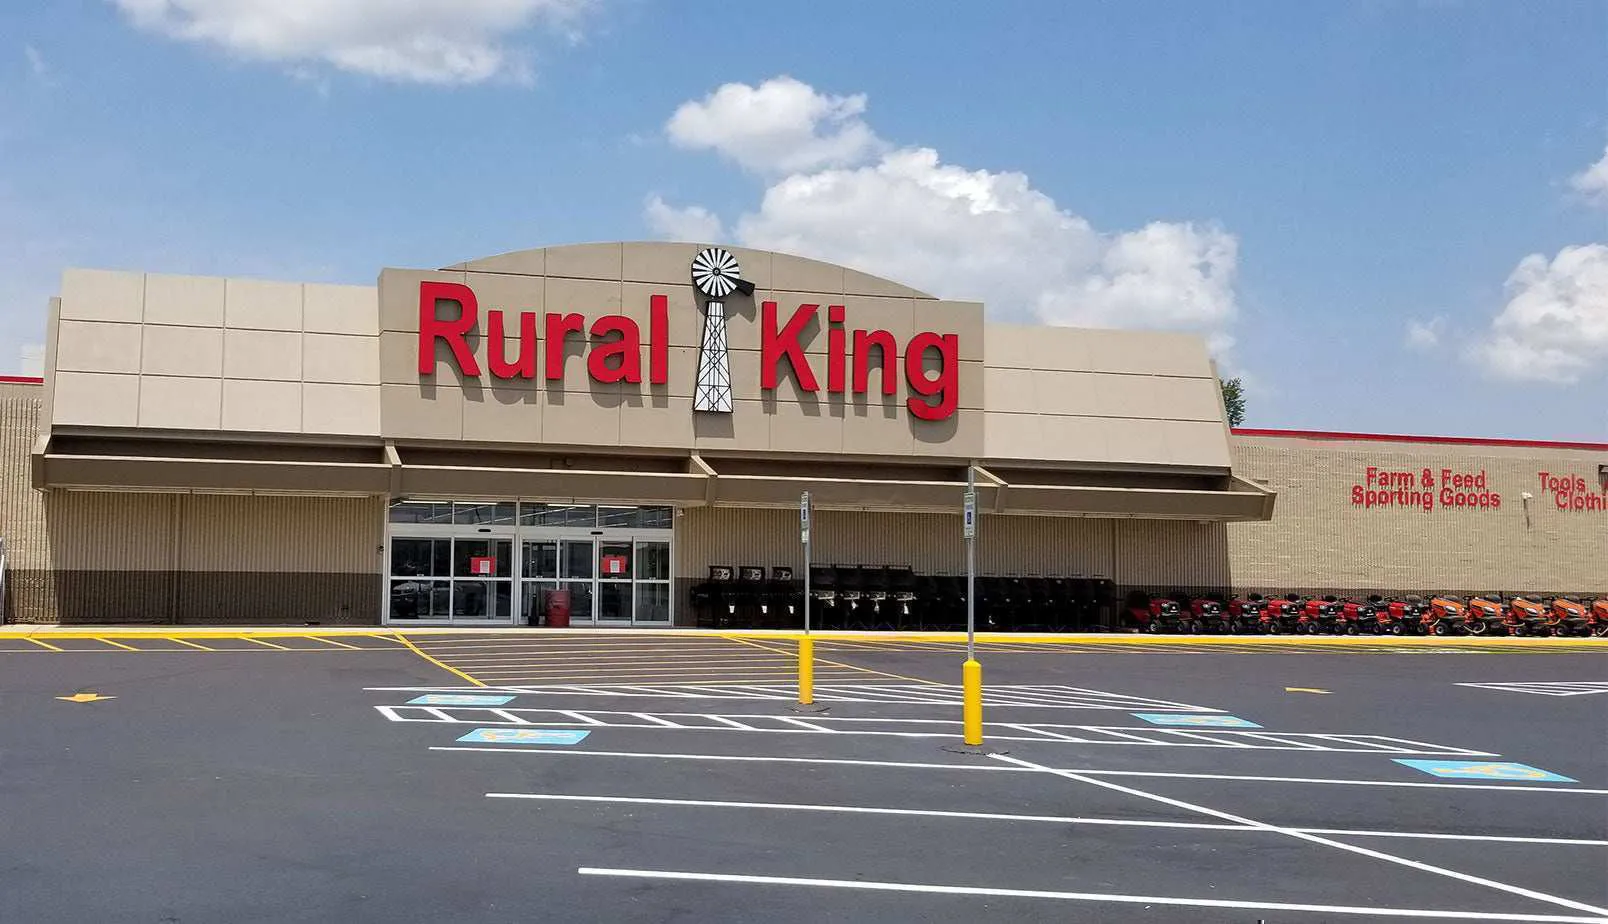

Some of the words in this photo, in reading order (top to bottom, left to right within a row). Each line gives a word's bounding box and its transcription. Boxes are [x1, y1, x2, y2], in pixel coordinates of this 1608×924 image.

[419, 281, 668, 385] Rural
[761, 301, 959, 421] King
[1366, 467, 1414, 486] Farm
[1421, 468, 1434, 487] &
[1442, 469, 1486, 489] Feed
[1538, 472, 1586, 492] Tools
[1352, 485, 1433, 510] Sporting
[1439, 487, 1500, 508] Goods
